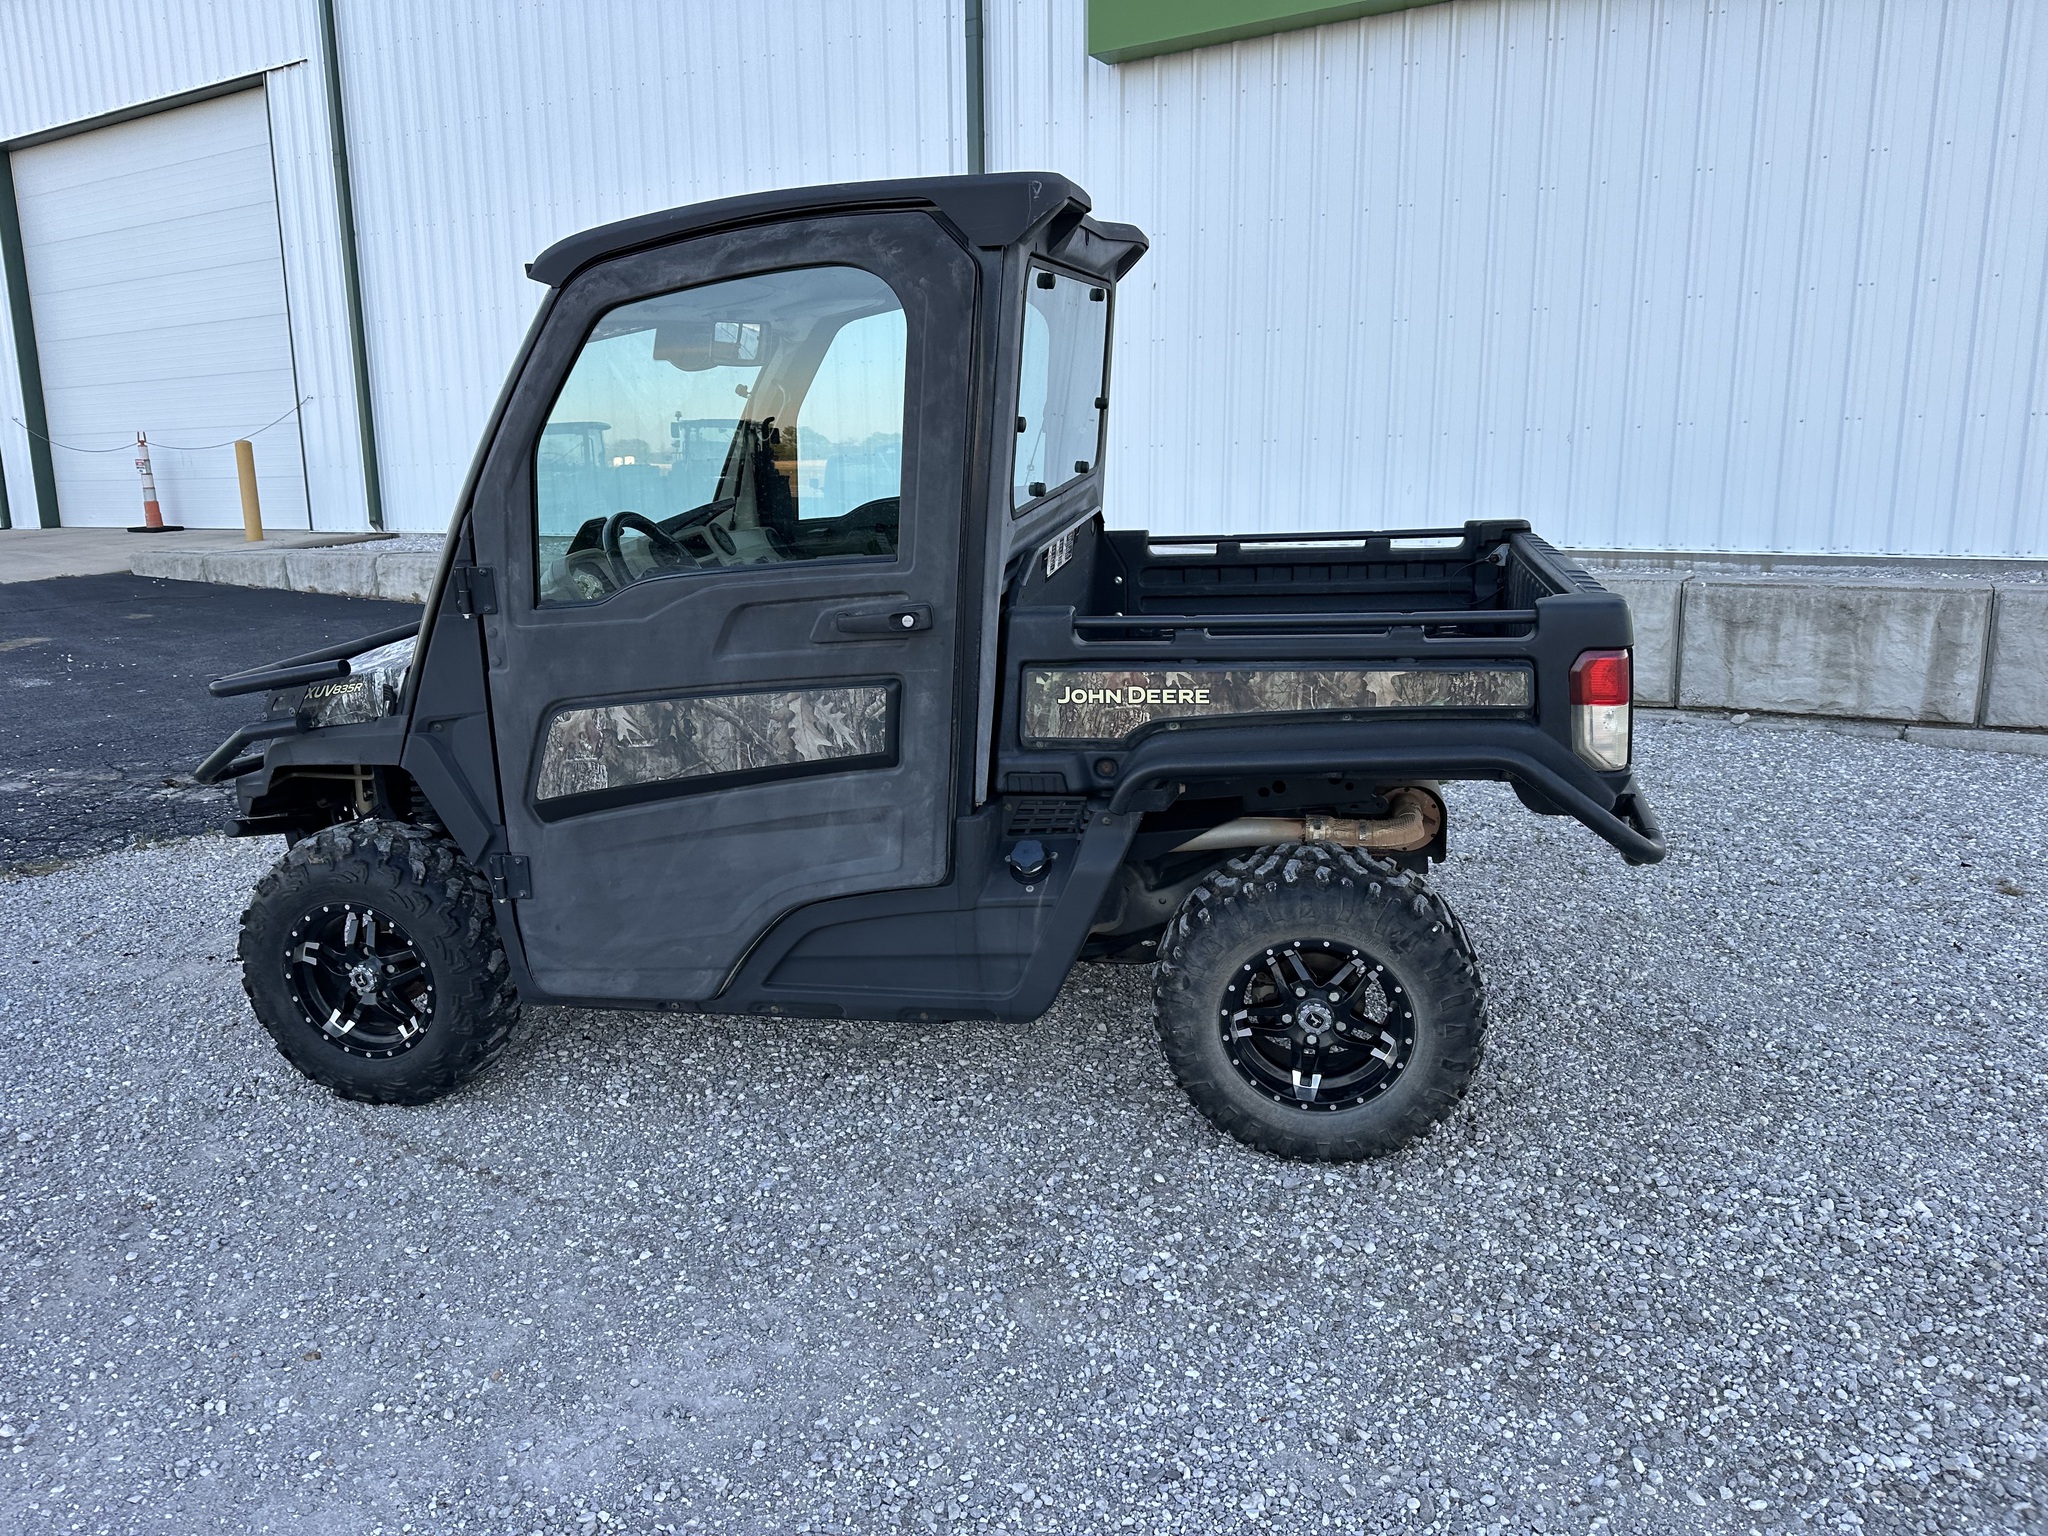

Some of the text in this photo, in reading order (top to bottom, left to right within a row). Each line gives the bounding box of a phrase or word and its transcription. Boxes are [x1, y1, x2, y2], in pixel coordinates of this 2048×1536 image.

[304, 682, 363, 699] XUV835R
[1057, 686, 1210, 704] JOHN DEERE
